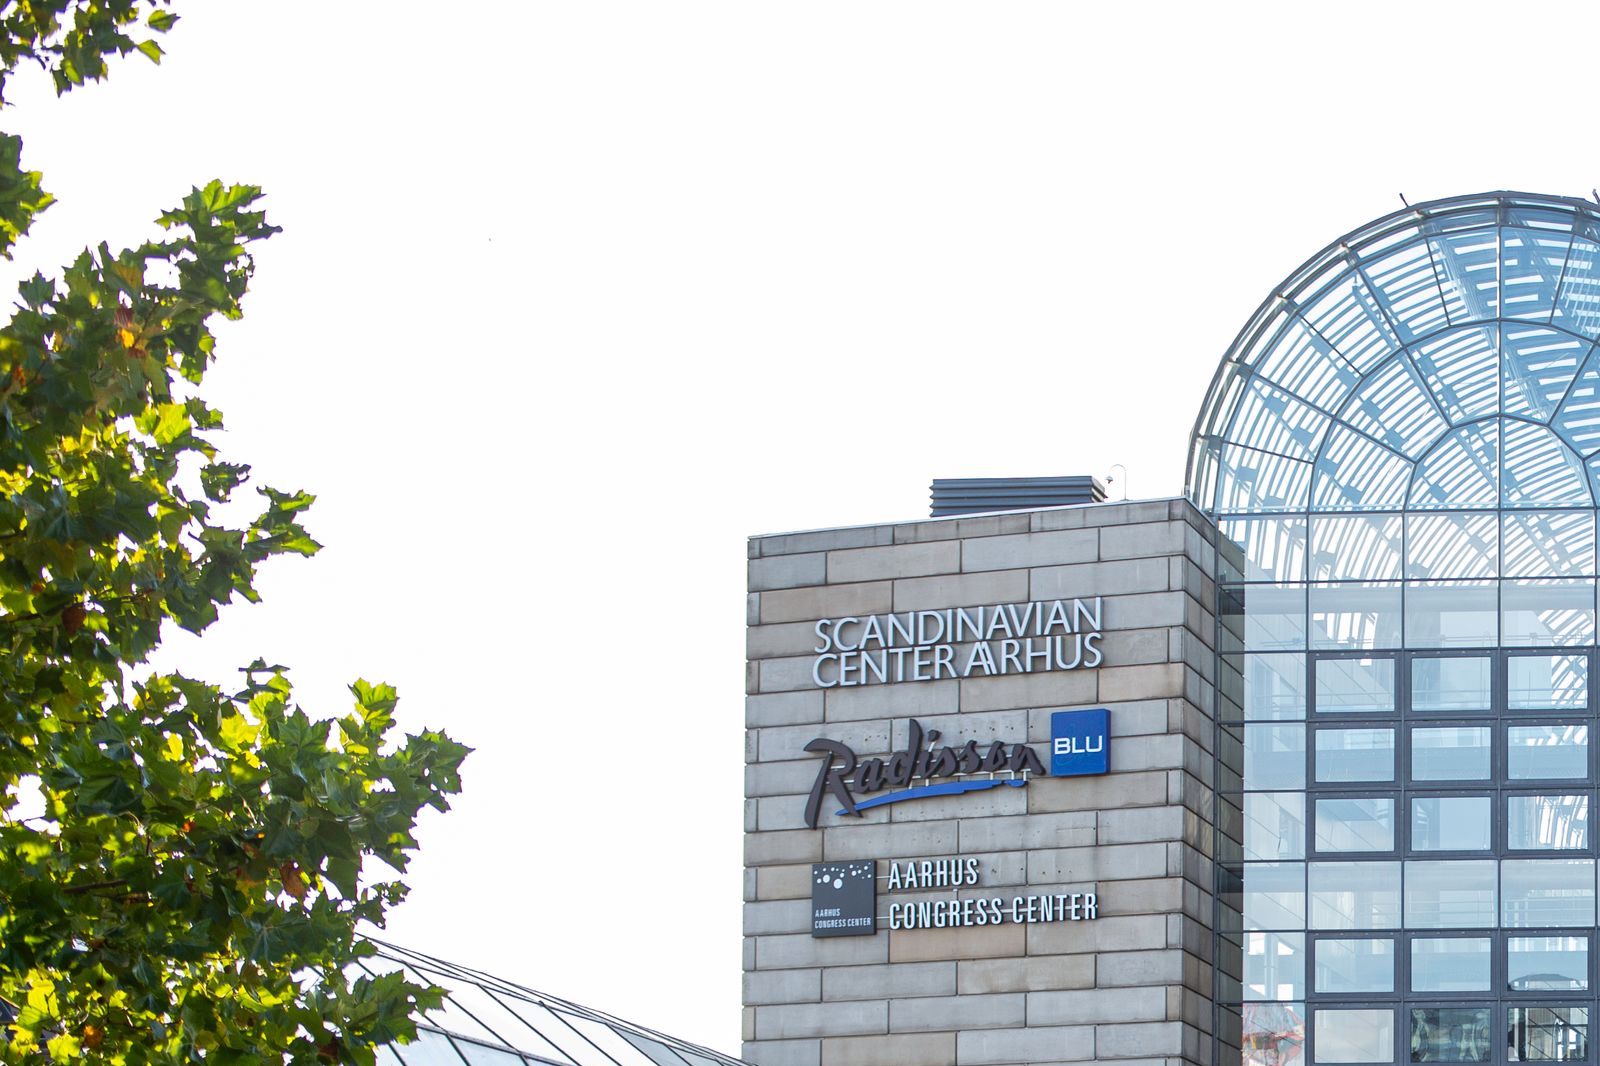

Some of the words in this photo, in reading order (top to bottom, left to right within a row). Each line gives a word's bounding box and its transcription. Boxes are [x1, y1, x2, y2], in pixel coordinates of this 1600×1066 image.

[814, 597, 1101, 653] SCANDINAVIAN
[812, 645, 957, 688] CENTER
[1054, 735, 1103, 755] BLU
[803, 719, 1046, 829] Radisson
[887, 858, 979, 890] AARHUS
[815, 908, 840, 918] AARHUS
[815, 919, 846, 928] CONGRESS
[847, 917, 872, 927] CENTER
[889, 898, 1002, 930] CONGRESS
[1012, 893, 1098, 924] CENTER
